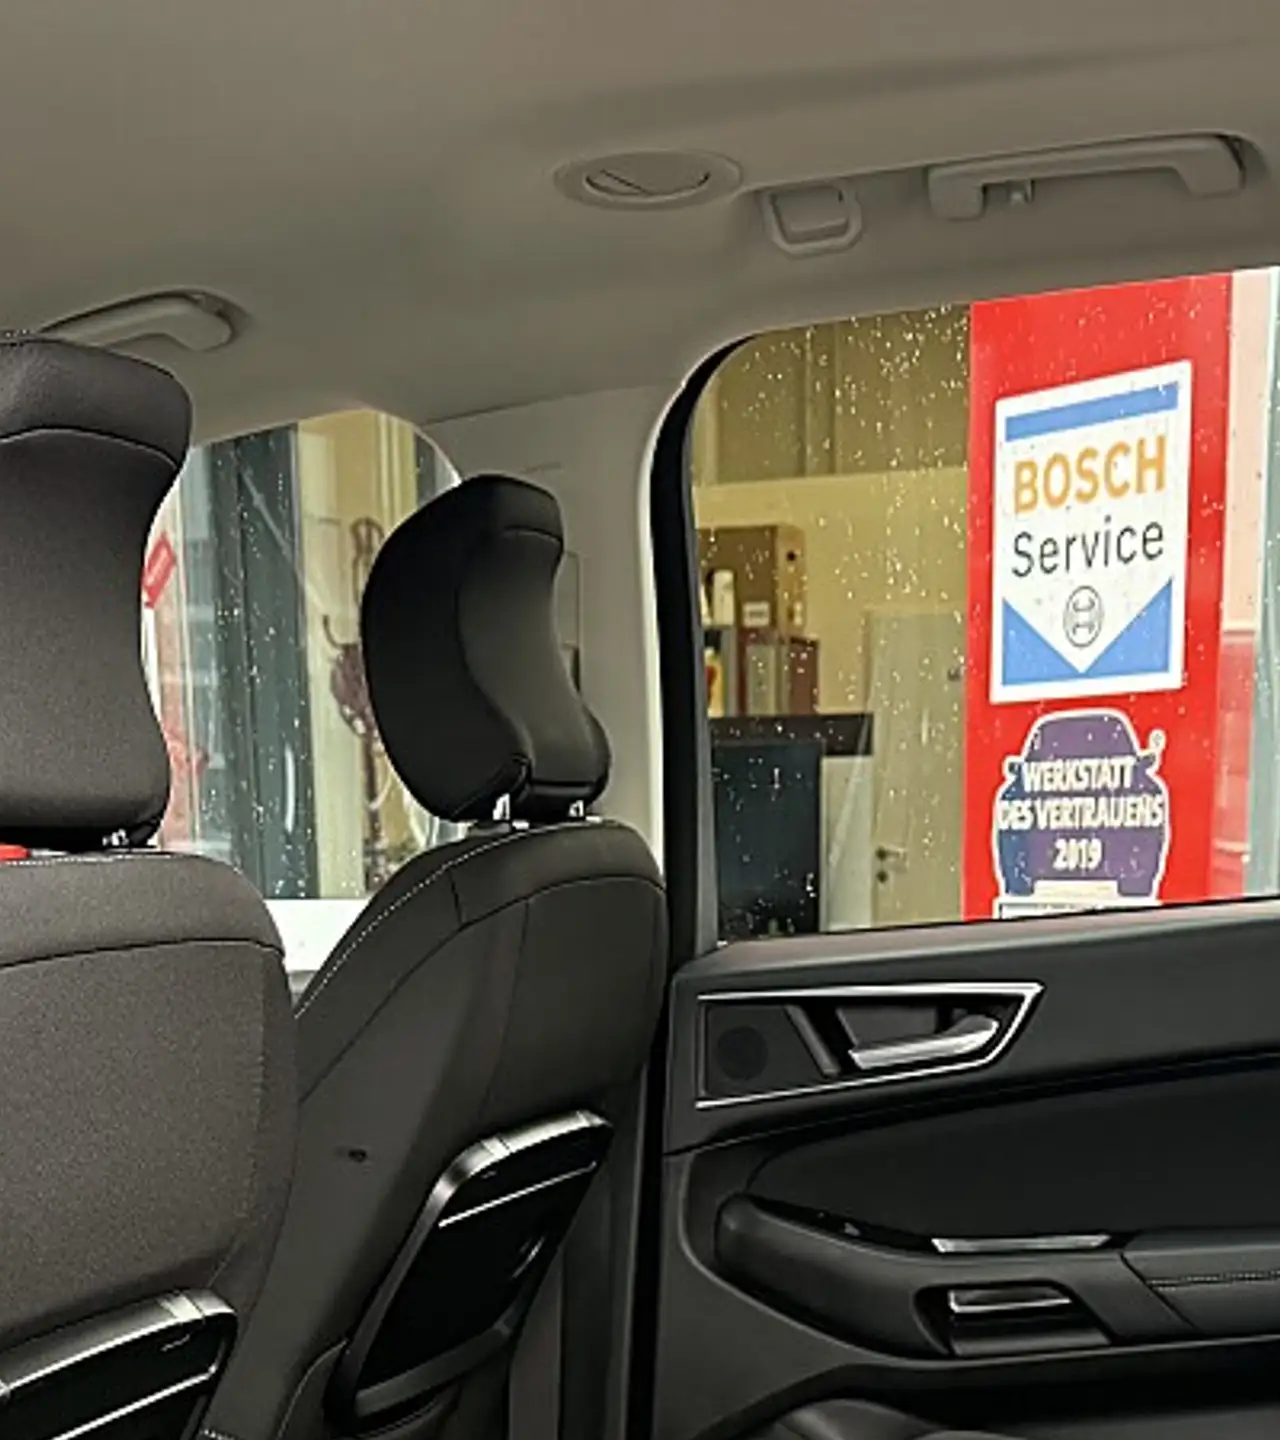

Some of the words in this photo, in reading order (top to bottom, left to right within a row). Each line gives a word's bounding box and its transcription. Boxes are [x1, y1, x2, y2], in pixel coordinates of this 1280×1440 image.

[1013, 434, 1167, 514] BOSCH
[1011, 514, 1165, 578] Service
[1021, 755, 1136, 792] WERKSTATT
[998, 799, 1033, 831] DES
[1035, 793, 1163, 830] VERTRAUENS
[1053, 838, 1102, 870] 2019
